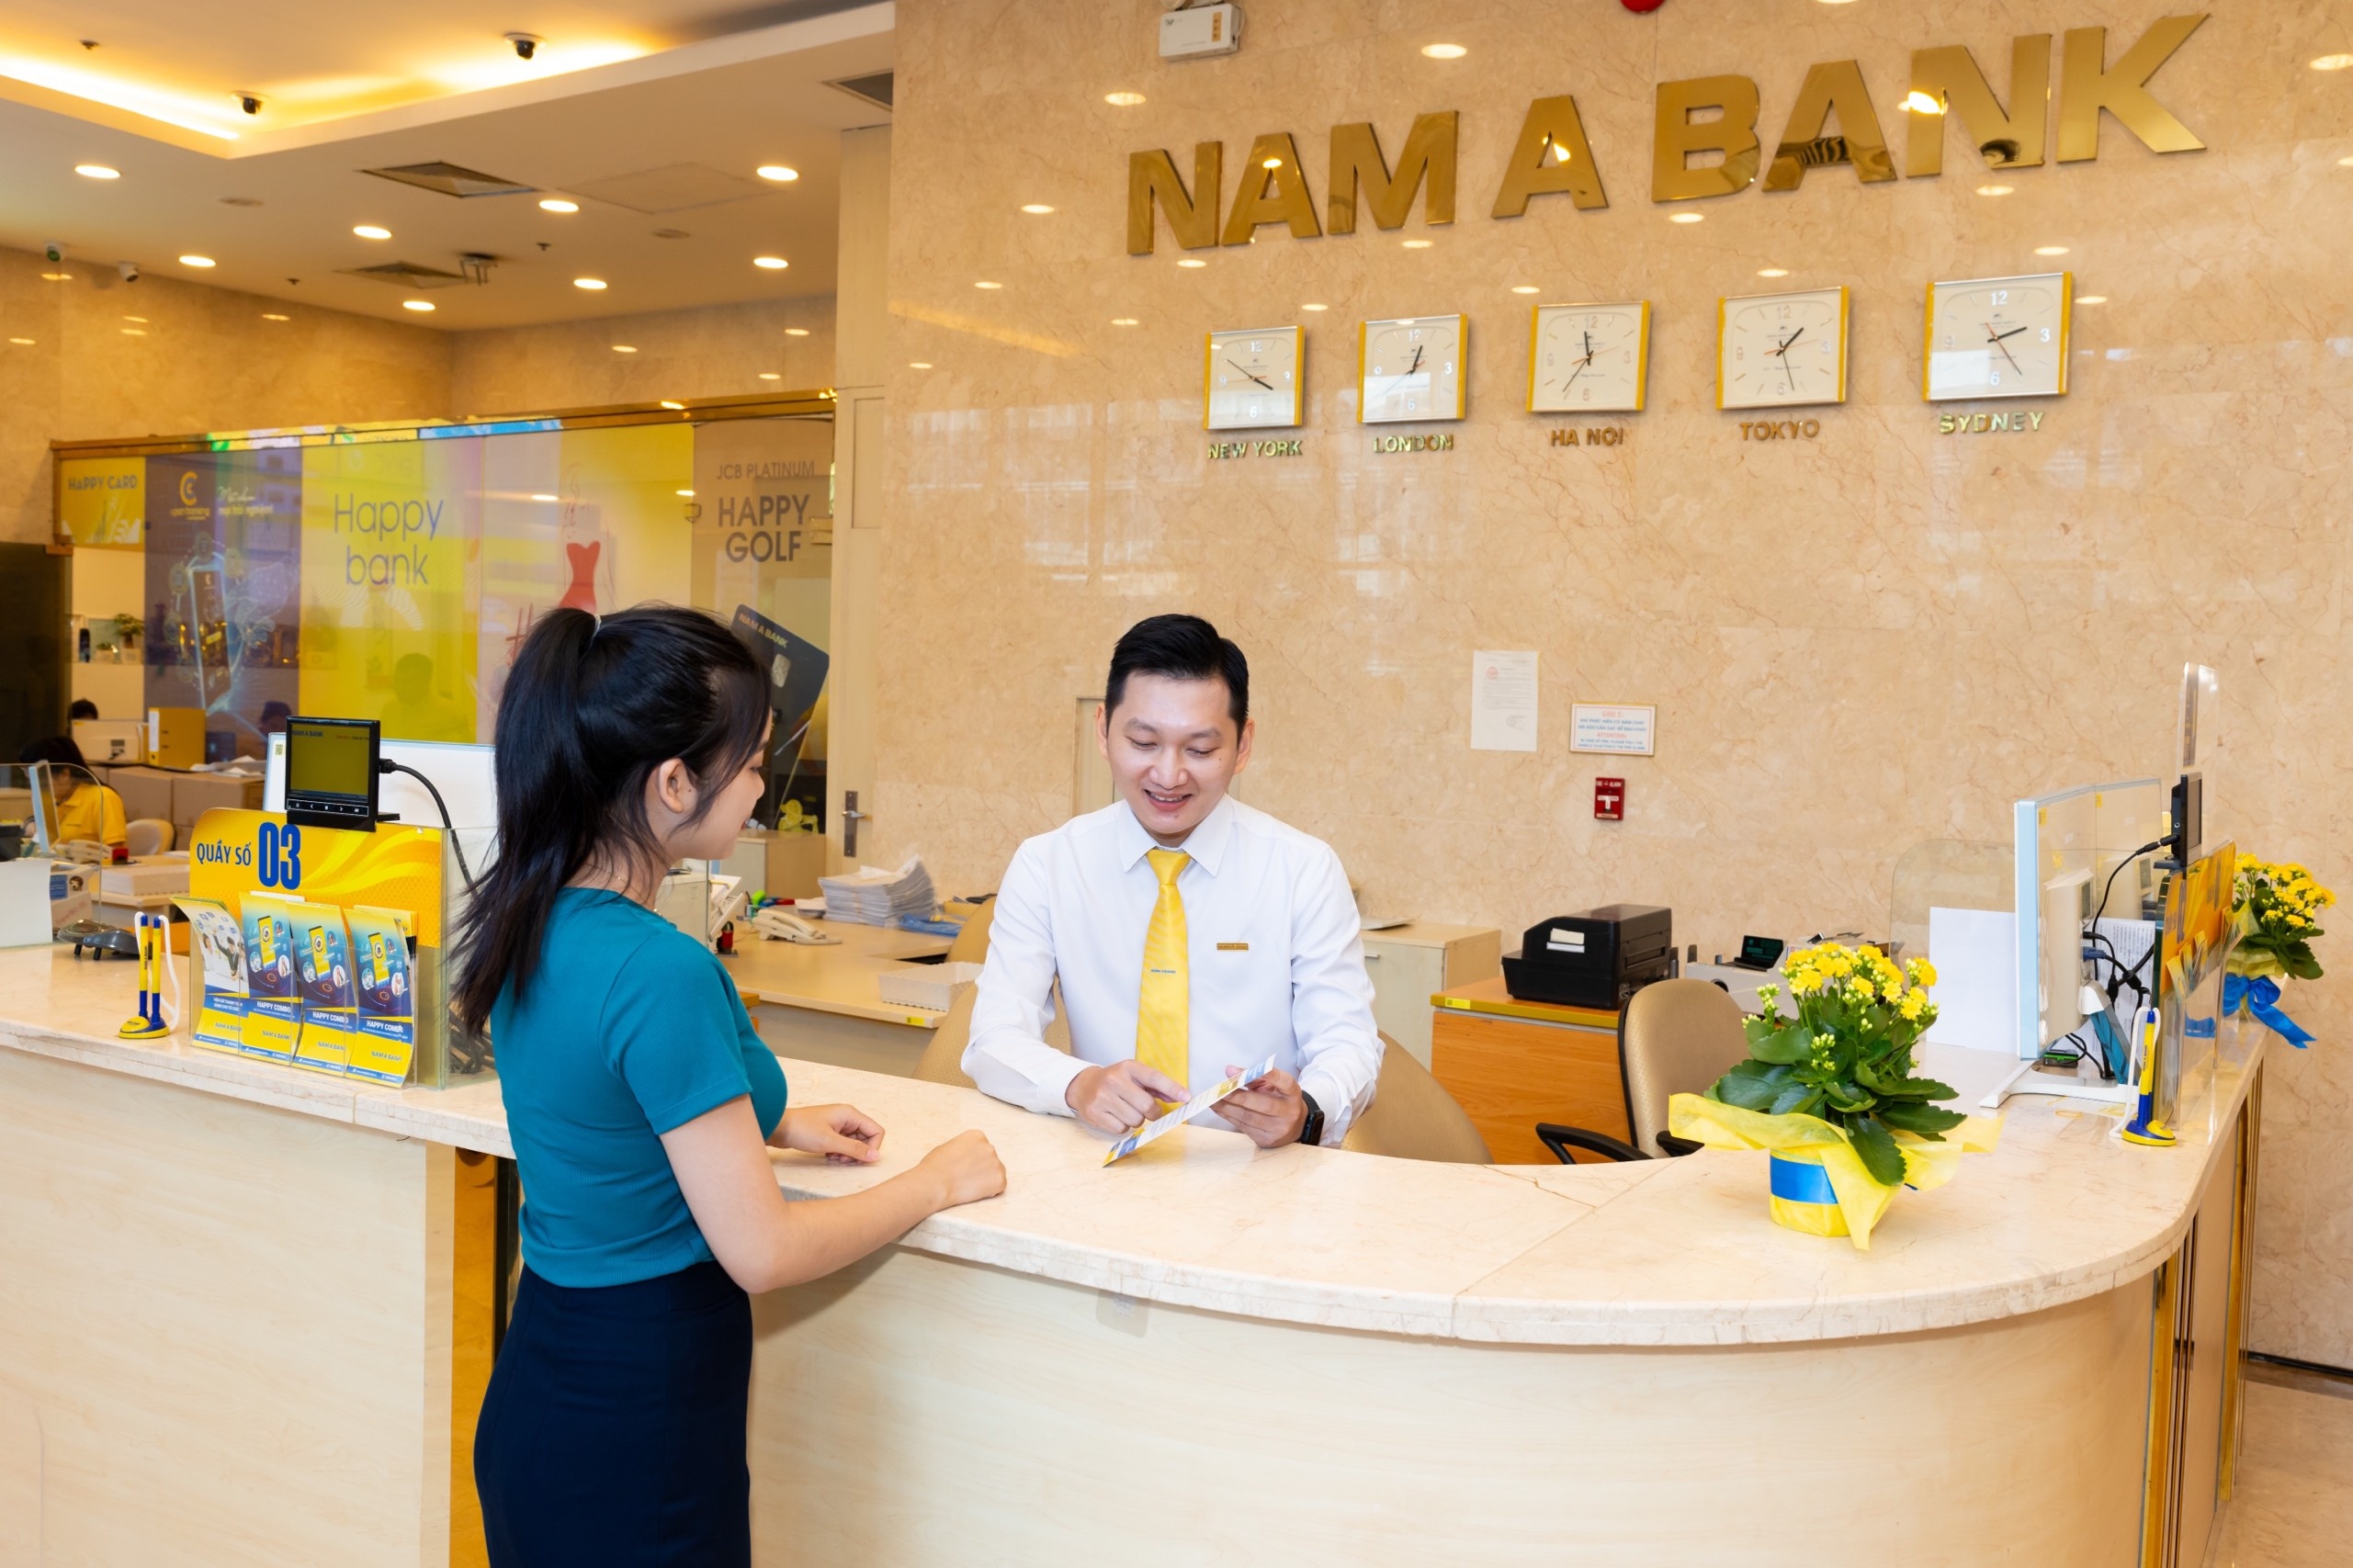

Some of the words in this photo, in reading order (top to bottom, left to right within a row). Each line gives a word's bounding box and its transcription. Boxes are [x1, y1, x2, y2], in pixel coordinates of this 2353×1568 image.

[1126, 110, 1459, 255] NAM
[1490, 95, 1609, 219] A
[1651, 13, 2211, 202] BANK
[1991, 290, 2008, 306] 12
[1777, 305, 1791, 320] 12
[1585, 315, 1599, 329] 12
[1408, 329, 1422, 343] 12
[2040, 328, 2050, 343] 3
[1250, 340, 1262, 353] 12
[1623, 350, 1631, 364] 3
[1444, 362, 1453, 374] 3
[1219, 376, 1227, 387] 9
[1284, 371, 1291, 382] 3
[1990, 371, 1999, 386] 6
[1582, 388, 1590, 401] 6
[1777, 382, 1786, 396] 6
[1250, 406, 1258, 418] 6
[1408, 398, 1416, 412] 6
[1739, 419, 1820, 441] TOKYO
[1940, 412, 2043, 434] SYDNEY
[1374, 434, 1454, 454] LONDON
[1551, 429, 1579, 447] HA
[1587, 426, 1623, 446] NOI
[1207, 443, 1247, 459] NEW
[1253, 440, 1302, 457] YORK
[717, 464, 741, 479] JCB
[747, 460, 815, 479] PLATINUM
[68, 476, 104, 491] HAPPY
[107, 475, 138, 490] CARD
[334, 492, 443, 542] Happy
[718, 494, 809, 527] HAPPY
[726, 531, 801, 563] GOLF
[346, 544, 428, 585] bank
[739, 613, 759, 630] NAM
[764, 628, 788, 649] BANK
[197, 840, 232, 864] QUẦY
[235, 842, 252, 865] SỐ
[259, 822, 300, 890] 03
[257, 1001, 273, 1010] HAPPY
[312, 1011, 330, 1021] HAPPY
[367, 1020, 384, 1029] HAPPY
